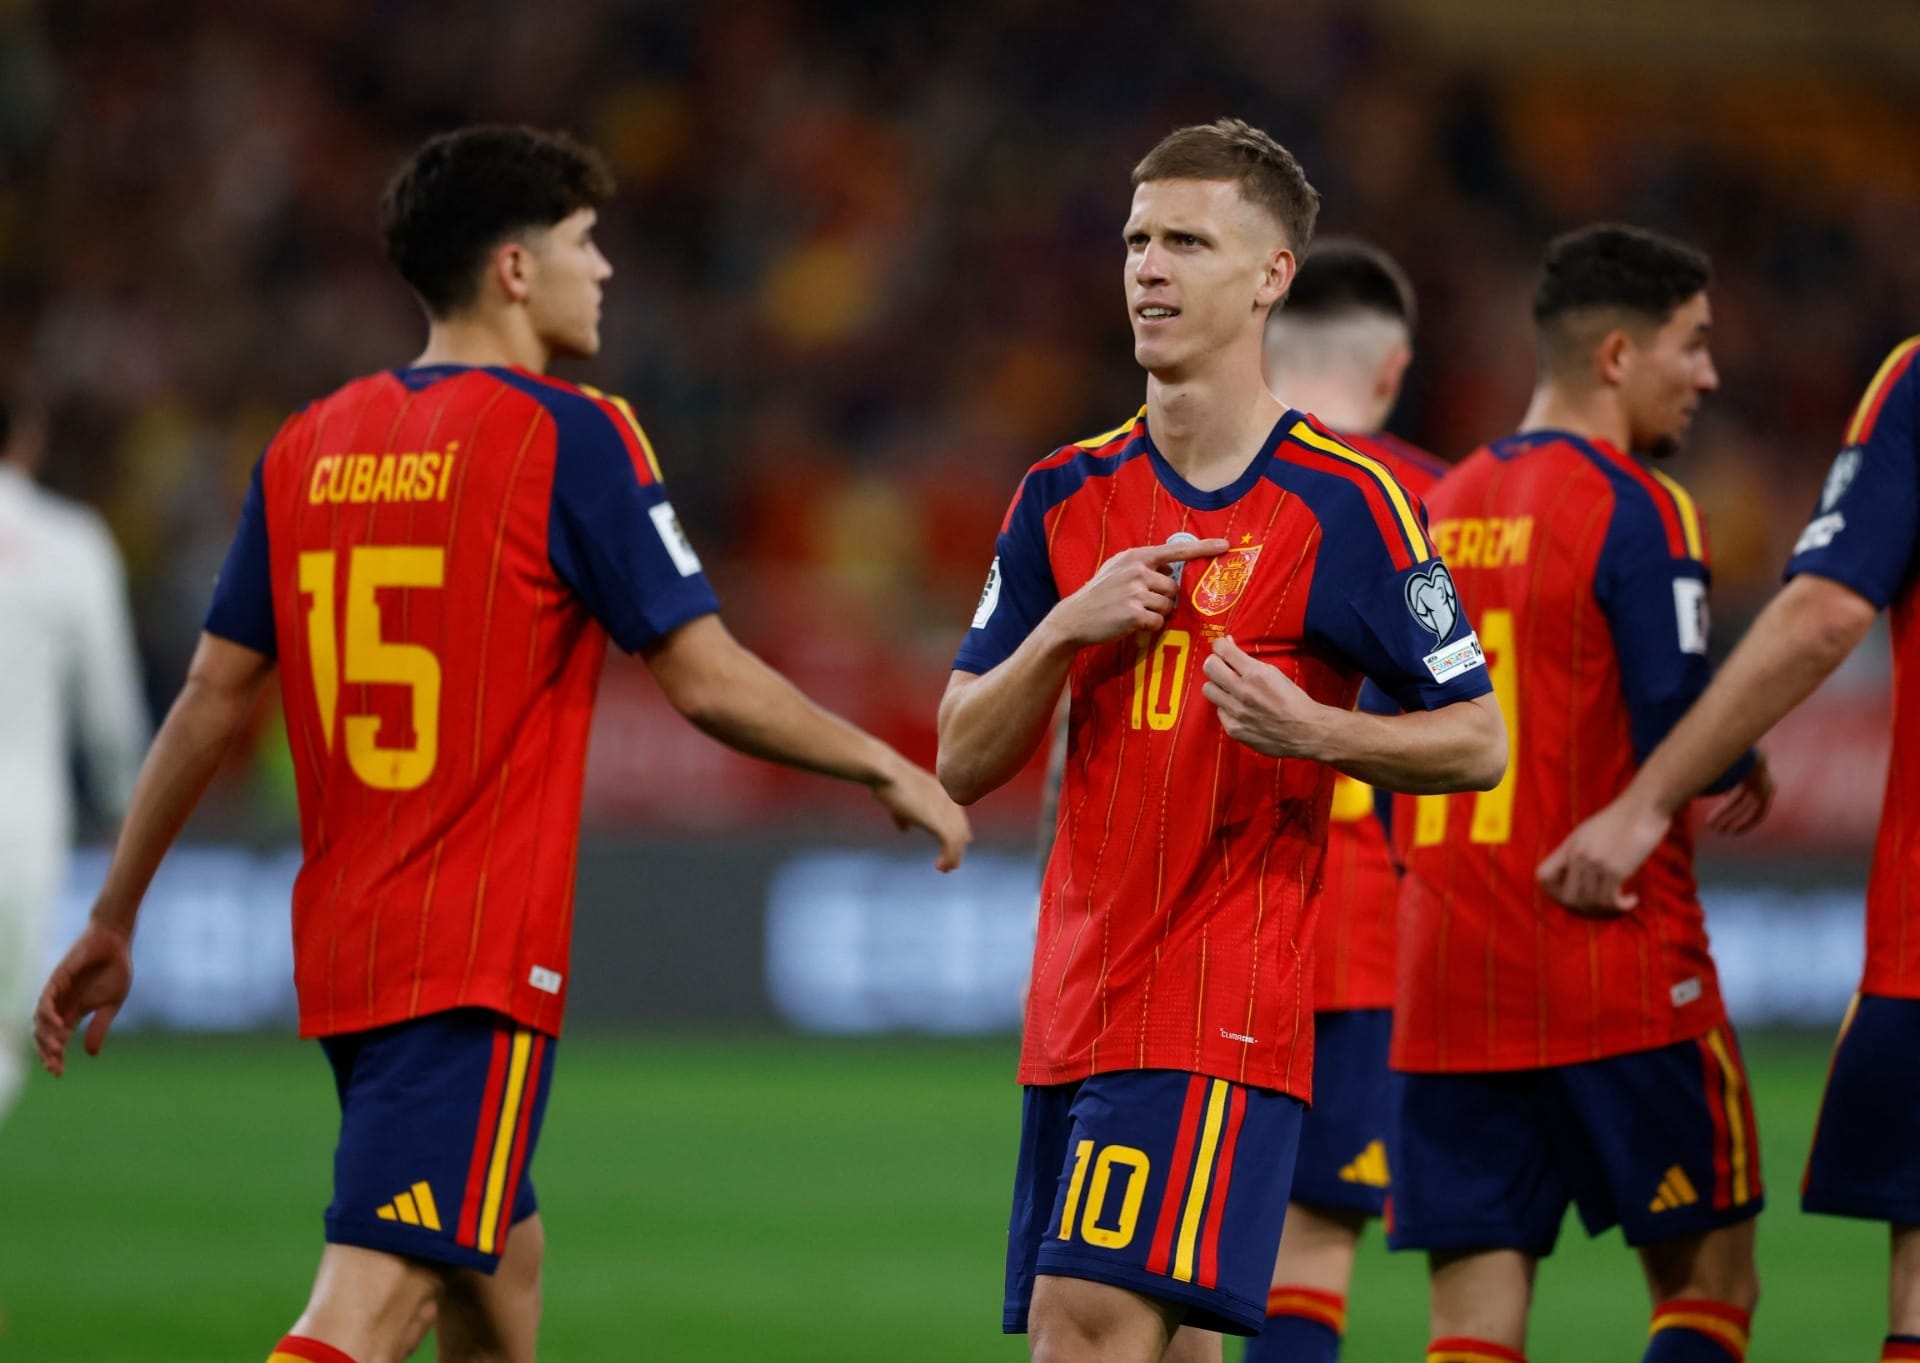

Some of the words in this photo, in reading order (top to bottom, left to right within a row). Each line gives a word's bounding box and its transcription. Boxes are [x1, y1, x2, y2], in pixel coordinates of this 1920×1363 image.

[309, 441, 459, 505] CUBARSÍ
[1429, 515, 1534, 568] EREMI
[298, 545, 446, 791] 15
[1130, 629, 1192, 732] 10
[1414, 610, 1520, 847] 1
[1057, 1139, 1151, 1250] 10
